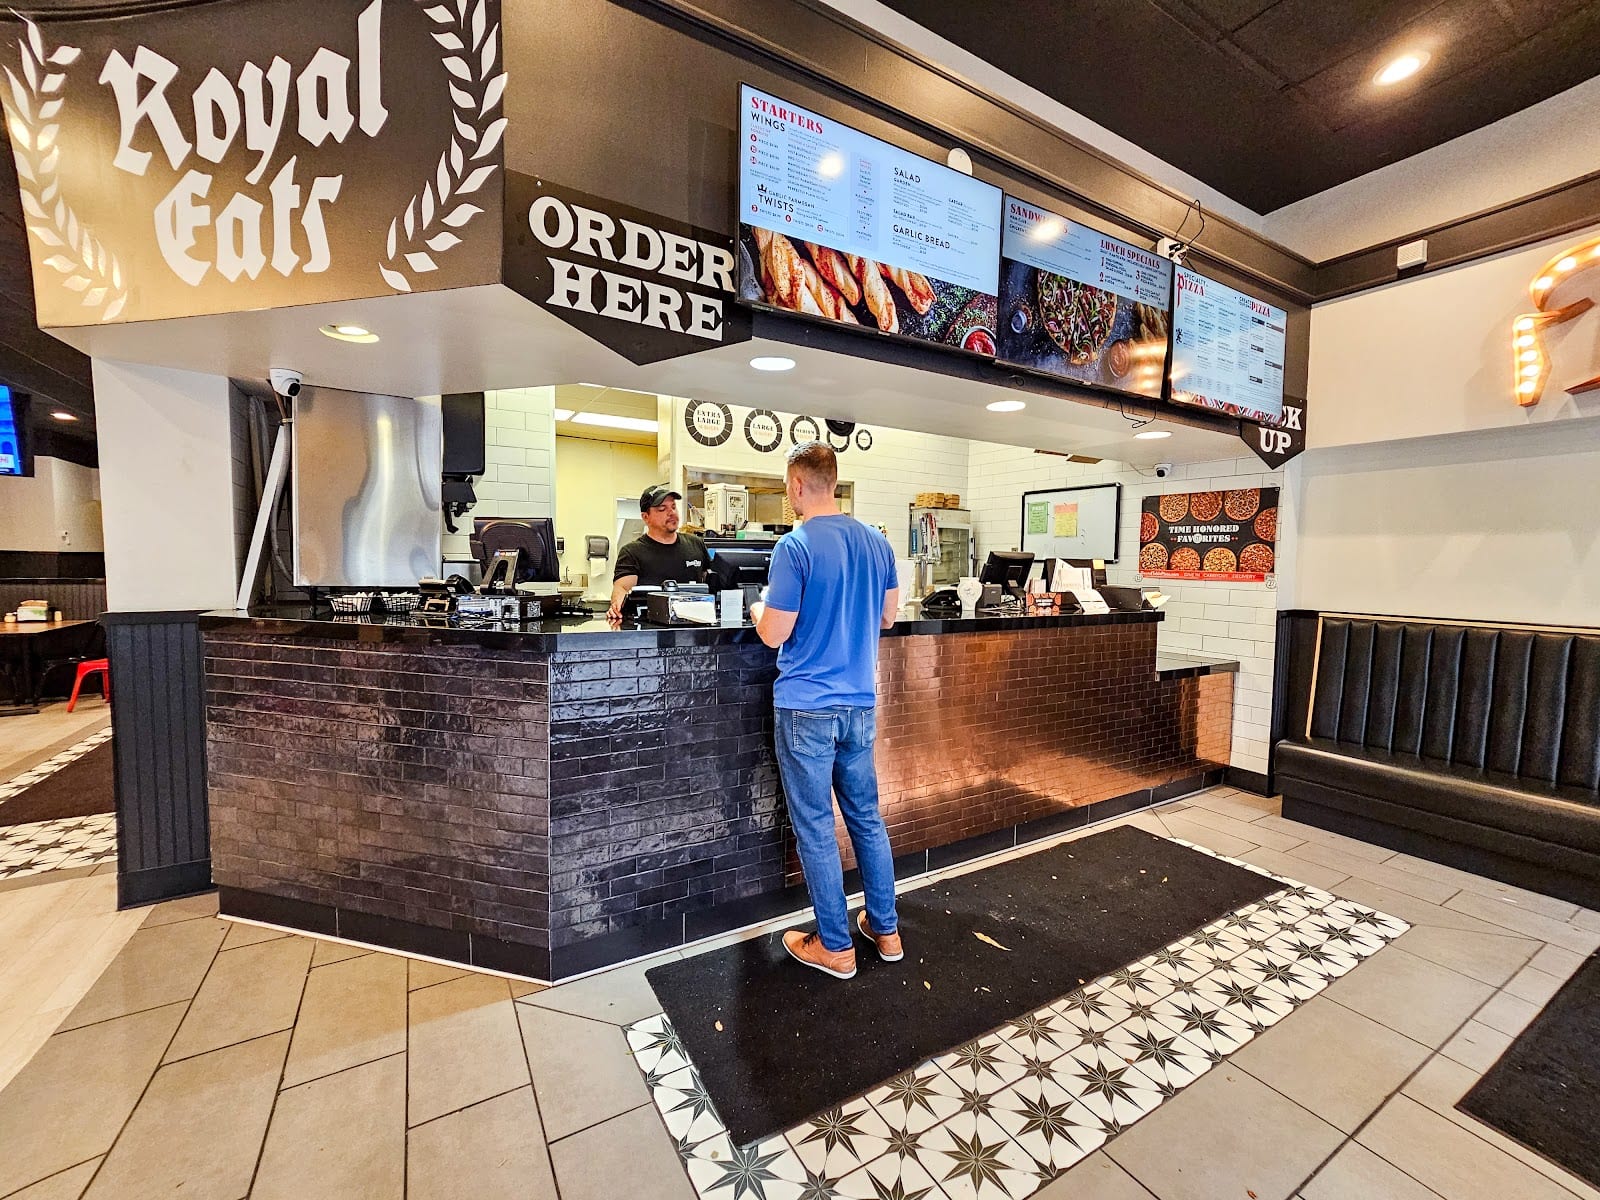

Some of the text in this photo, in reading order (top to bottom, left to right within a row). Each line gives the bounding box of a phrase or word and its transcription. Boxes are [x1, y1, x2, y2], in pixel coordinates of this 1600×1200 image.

[98, 0, 388, 185] Royal
[751, 96, 823, 134] STARTERS
[751, 111, 785, 132] WINGS
[894, 167, 921, 183] SALAD
[758, 193, 794, 213] TWISTS
[768, 190, 815, 209] GARLIC PARMESAN
[154, 155, 343, 286] Eats
[529, 196, 735, 293] ORDER
[893, 224, 922, 241] GARLIC
[925, 234, 950, 249] BREAD
[1100, 239, 1125, 256] LUNCH
[1126, 248, 1160, 269] SPECIALS
[1099, 272, 1104, 283] 2
[1135, 270, 1141, 281] 3
[1183, 272, 1206, 287] SPECIALTY
[546, 256, 723, 342] HERE
[1177, 273, 1204, 308] PIZZA
[1251, 301, 1271, 318] PIZZA
[697, 409, 721, 419] EXTRA
[697, 417, 721, 426] LARGE
[752, 422, 774, 432] LARGE
[1259, 427, 1292, 454] UP
[1168, 524, 1240, 534] TIME HONORED
[1177, 533, 1231, 544] FAVORITES
